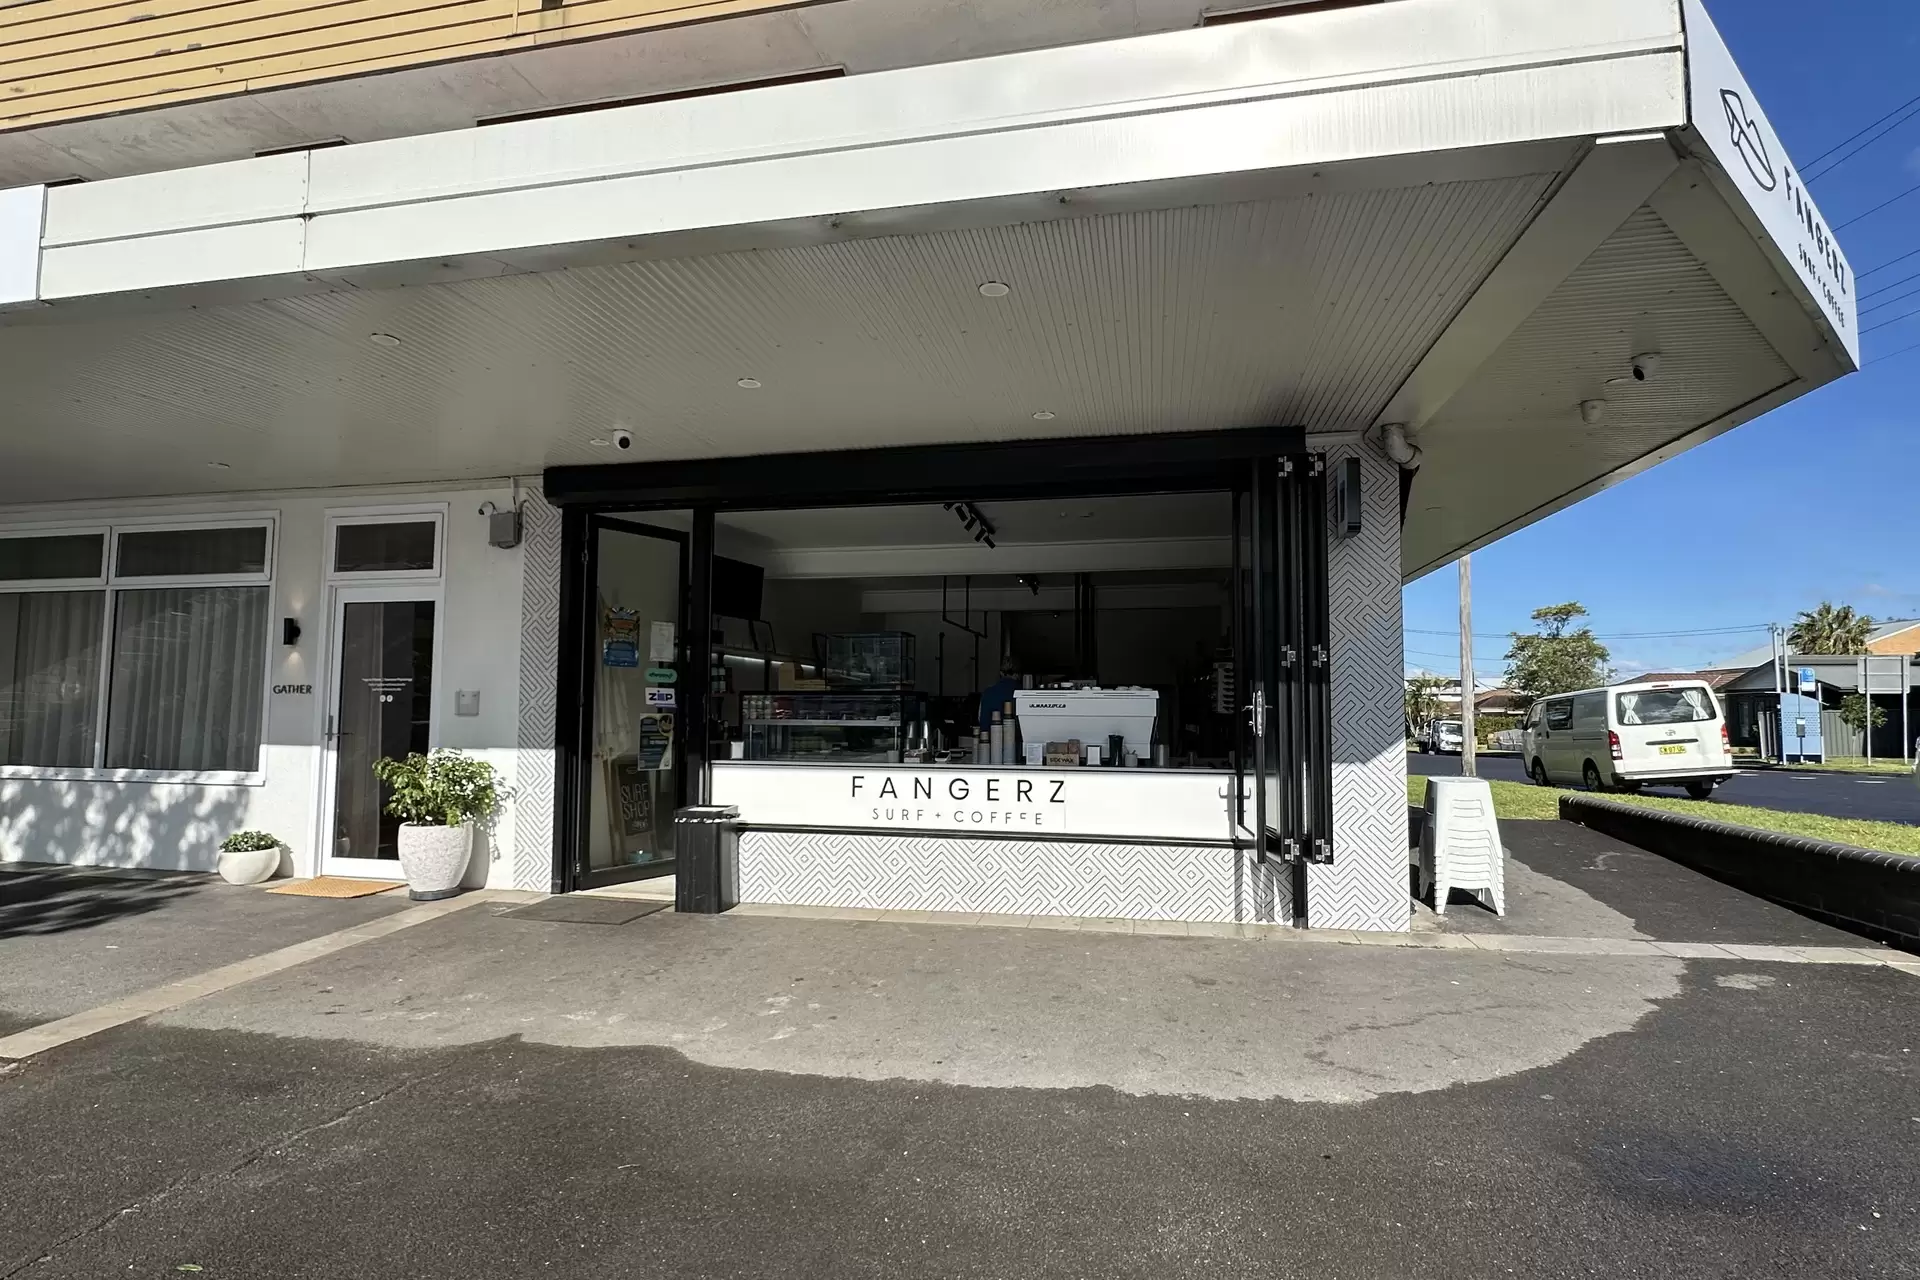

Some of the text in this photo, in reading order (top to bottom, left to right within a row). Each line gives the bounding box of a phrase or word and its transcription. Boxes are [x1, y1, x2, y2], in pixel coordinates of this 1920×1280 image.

[1784, 165, 1846, 295] FANGERZ
[1798, 243, 1816, 280] SURF
[1823, 282, 1845, 328] COFFEE
[272, 684, 313, 695] GATHER
[621, 782, 649, 804] SURF
[851, 776, 1065, 803] FANGERZ
[623, 800, 651, 820] SHOP
[872, 808, 924, 821] SURF
